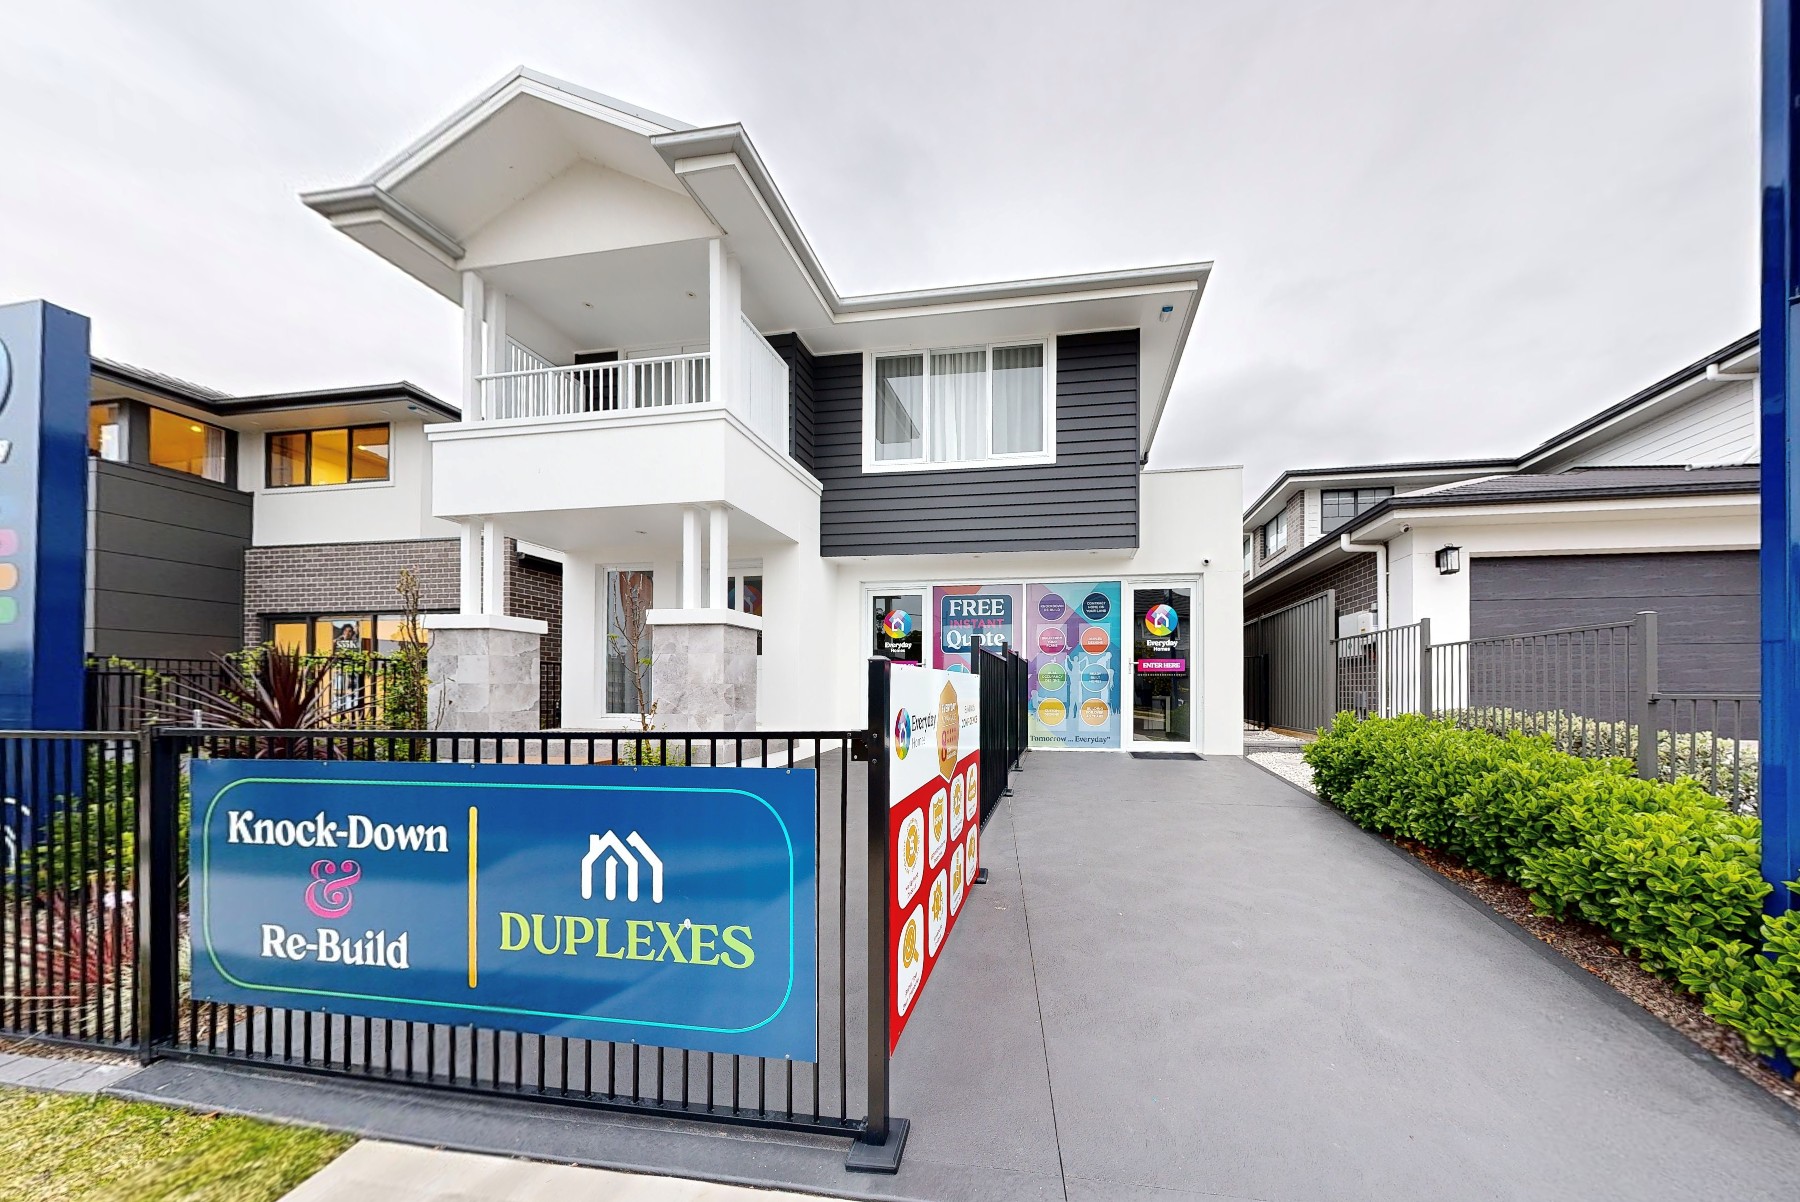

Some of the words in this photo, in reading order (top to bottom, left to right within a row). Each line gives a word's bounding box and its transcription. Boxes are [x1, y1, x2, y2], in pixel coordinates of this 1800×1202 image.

[949, 599, 1005, 617] FREE
[949, 618, 1005, 629] INSTANT
[884, 641, 913, 650] Everyday
[946, 629, 1006, 650] Quote
[1146, 639, 1178, 648] Everyday
[911, 711, 937, 733] Everyday
[1030, 735, 1067, 743] Tomorrow
[227, 810, 449, 854] Knock-Down
[304, 859, 362, 920] &
[260, 923, 410, 971] Re-Build
[499, 912, 756, 970] DUPLEXES
